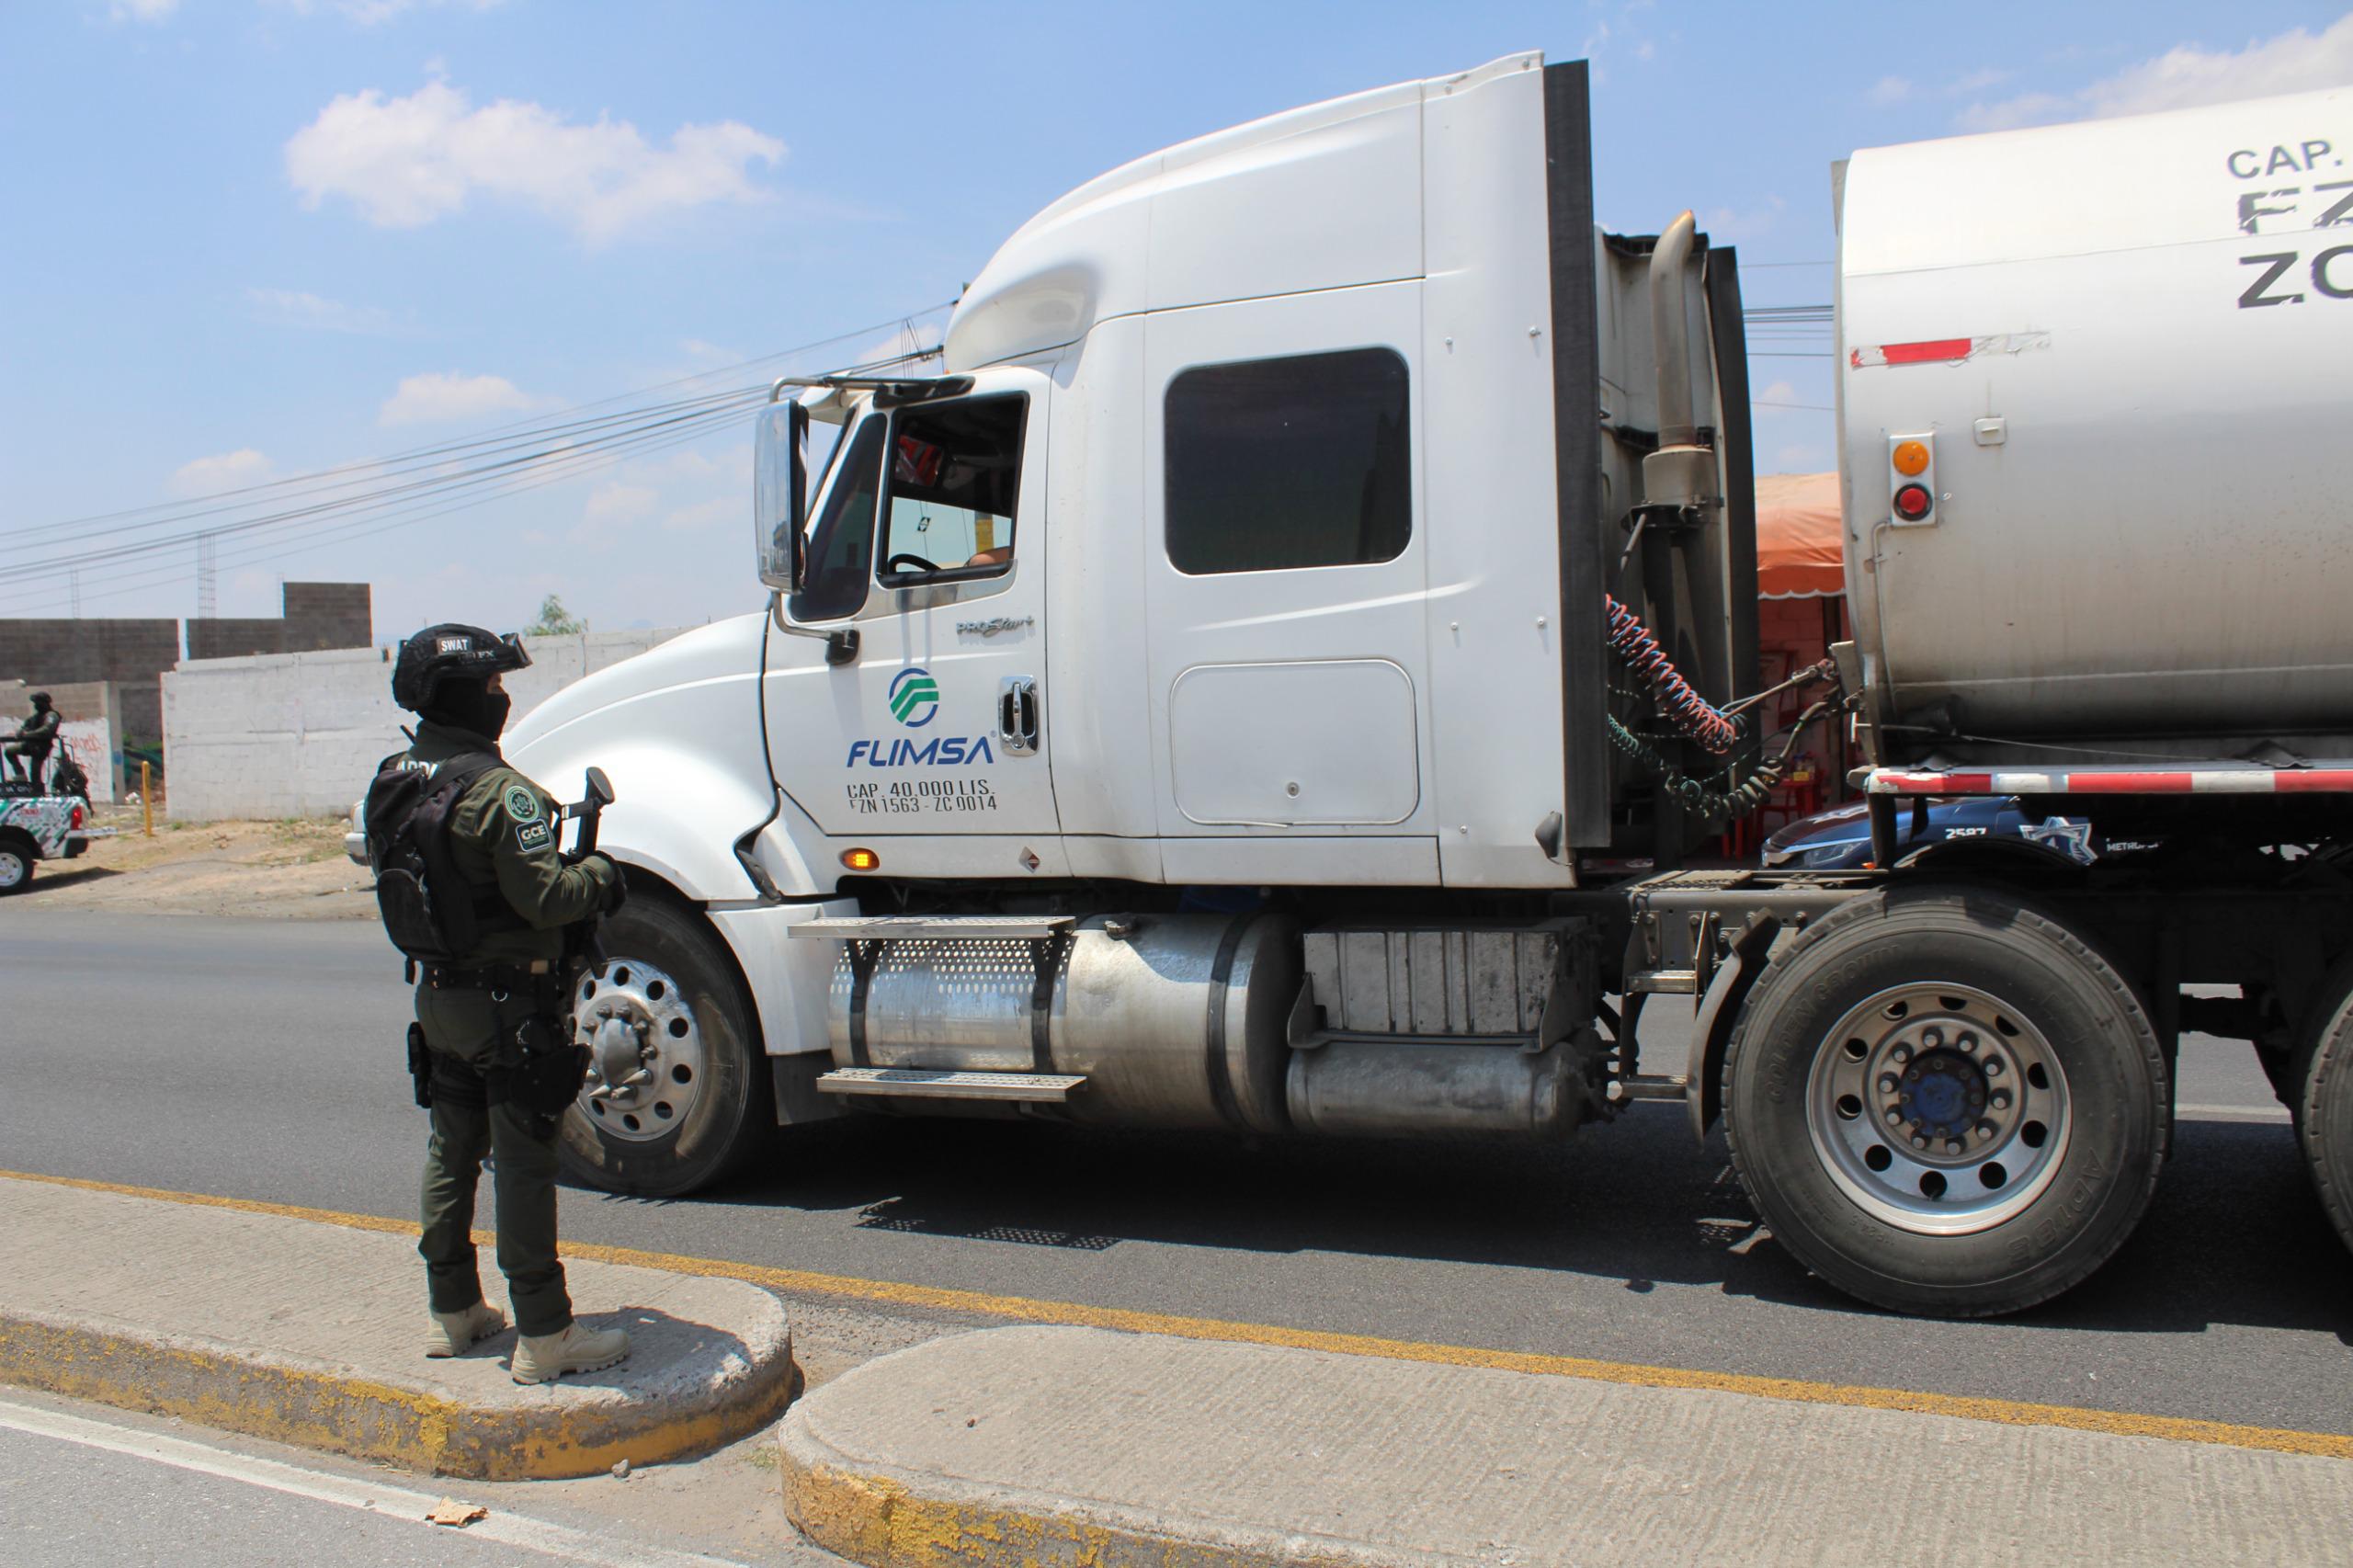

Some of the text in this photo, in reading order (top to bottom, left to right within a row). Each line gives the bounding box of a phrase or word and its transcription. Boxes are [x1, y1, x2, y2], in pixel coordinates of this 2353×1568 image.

[2227, 140, 2343, 179] CAP.
[441, 638, 468, 652] SWAT
[847, 736, 994, 767] FLIMSA
[847, 783, 885, 799] CAP.
[890, 781, 954, 798] 40.000
[882, 797, 919, 812] 1563
[935, 797, 952, 812] ZC
[521, 824, 546, 841] GCE
